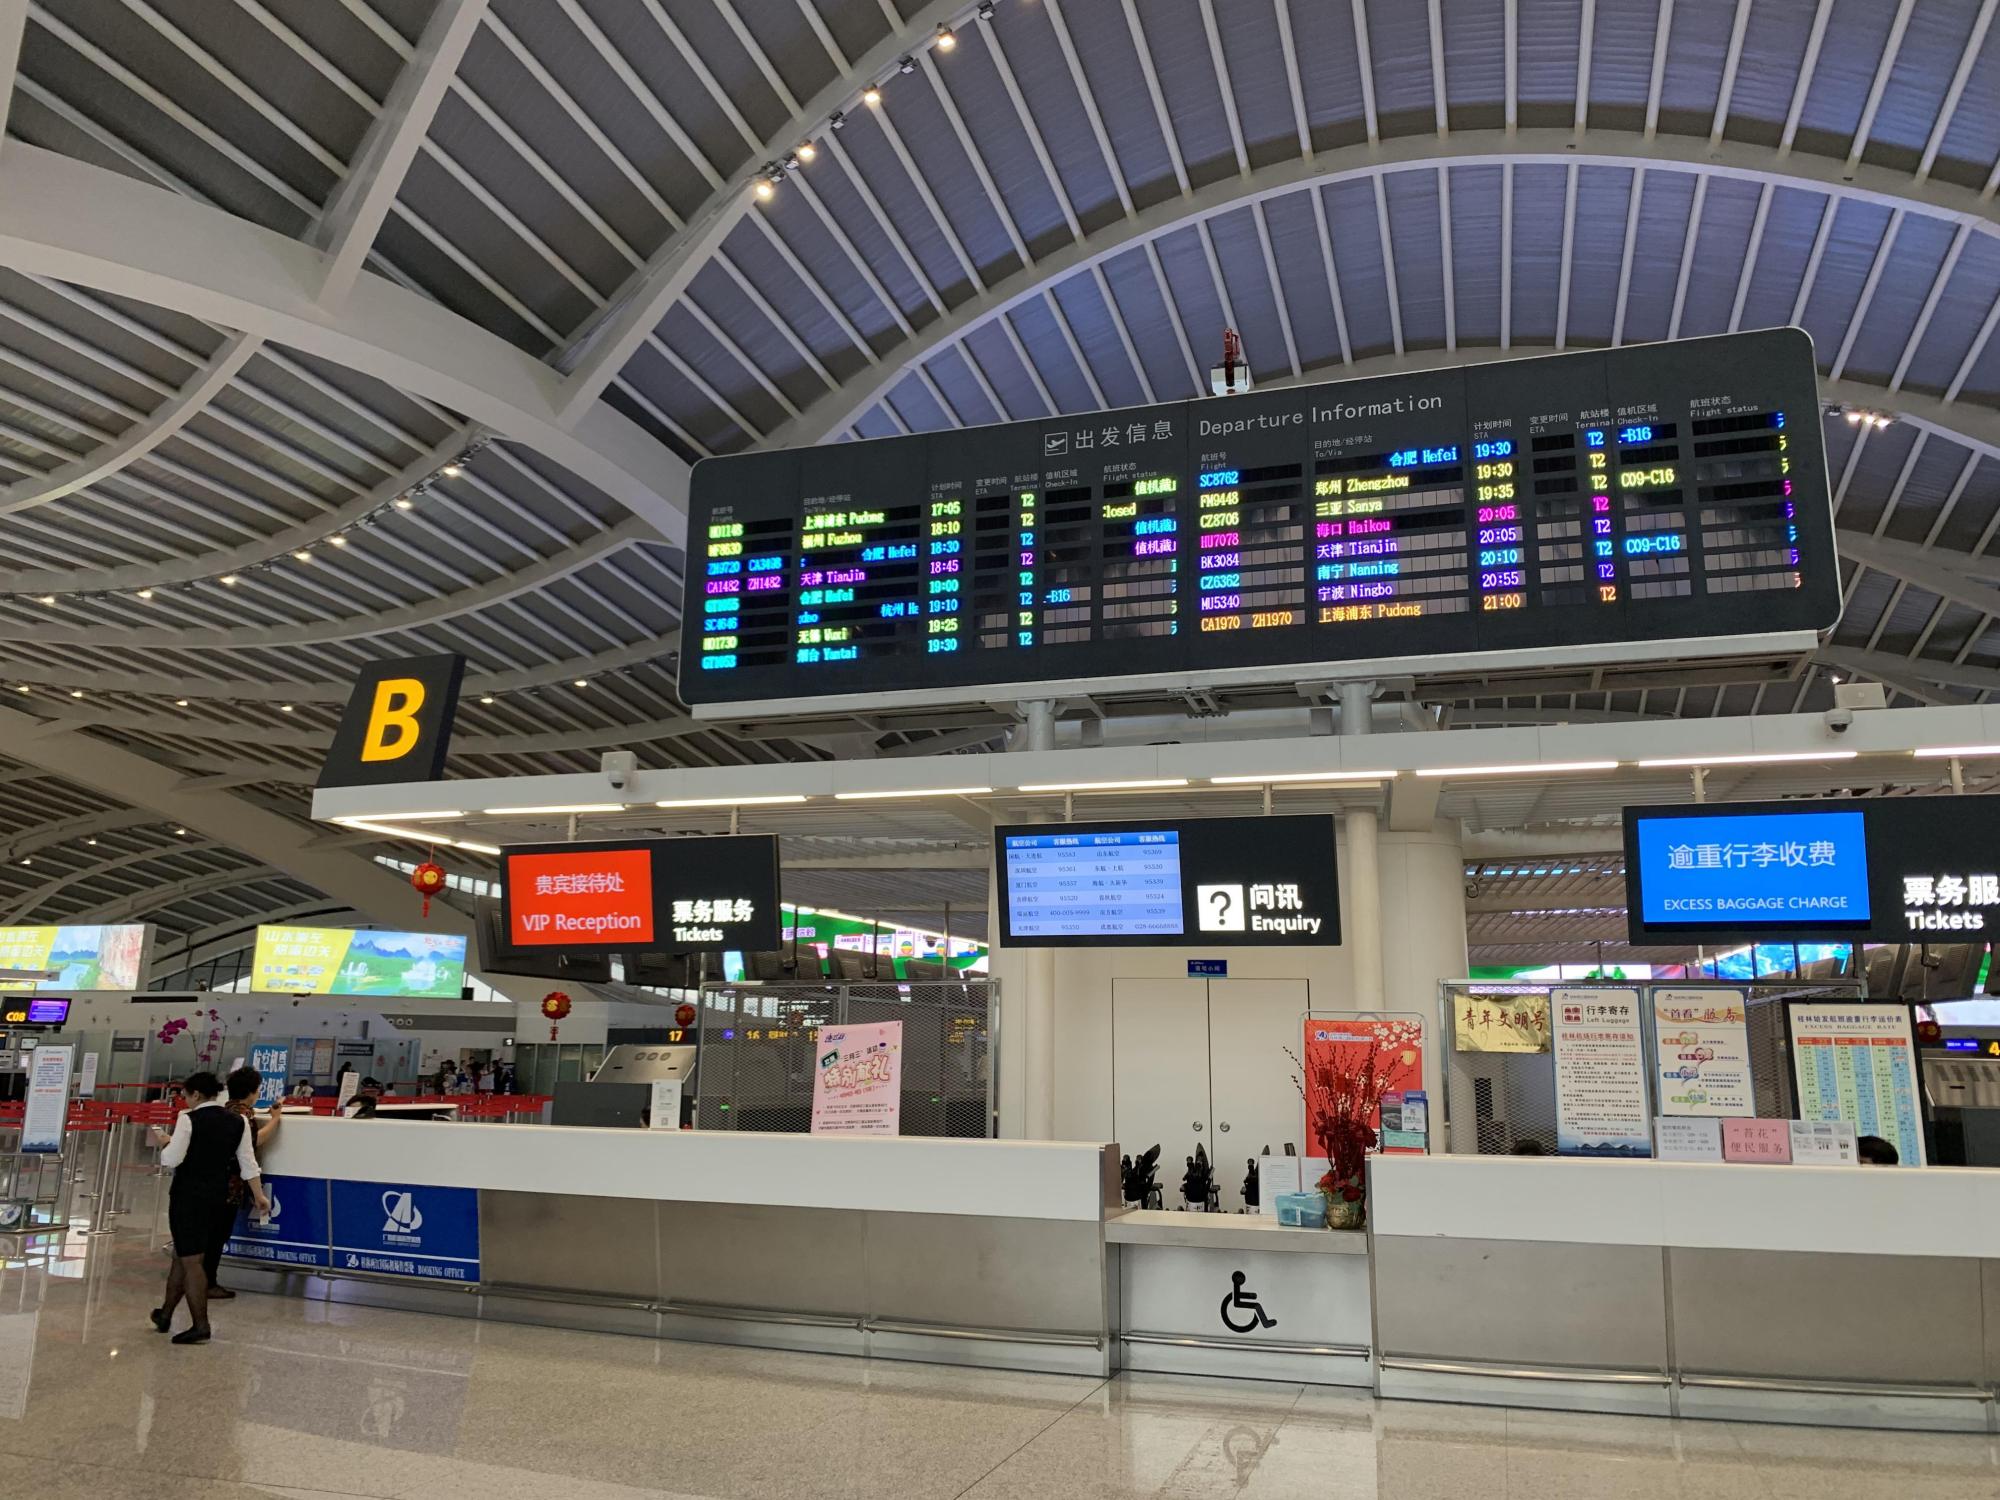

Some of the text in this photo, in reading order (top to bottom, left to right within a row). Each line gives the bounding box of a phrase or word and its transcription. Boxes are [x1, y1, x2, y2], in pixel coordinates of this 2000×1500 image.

[1617, 404, 1658, 416] 值机区域
[1690, 396, 1732, 408] 航班状态
[1580, 408, 1610, 420] 航站楼
[1690, 404, 1758, 418] Flight status
[1075, 396, 1442, 449] 出发信息 Departure Information
[1474, 419, 1512, 430] 计划时间
[1529, 413, 1569, 426] 变更时间
[1575, 418, 1614, 430] Terminal
[1617, 414, 1658, 426] Check-In
[1474, 431, 1489, 440] STA
[1530, 425, 1545, 434] ETA
[1618, 427, 1652, 444] -B16
[1588, 432, 1604, 446] T2
[1201, 452, 1227, 462] 航班号
[1315, 449, 1342, 459] To/Via
[1390, 447, 1458, 468] 合肥 Hefei
[1475, 442, 1511, 458] 19:30
[1103, 462, 1137, 474] 航班状态
[1200, 461, 1227, 470] Flight
[1590, 453, 1606, 468] T2
[1103, 472, 1128, 482] Flight
[1200, 472, 1239, 488] SC8762
[1476, 464, 1513, 480] 19:30
[1620, 468, 1675, 488] C09-C16
[1316, 474, 1409, 496] 郑州 Zhengzhou
[1592, 475, 1608, 490] T2
[930, 492, 943, 500] STA
[976, 488, 988, 496] ETA
[1021, 493, 1035, 507] T2
[1200, 491, 1239, 508] FM9448
[1478, 484, 1514, 501] 19:35
[931, 502, 960, 516] 17:05
[1103, 502, 1137, 518] losed
[1316, 498, 1383, 517] 三亚 Sanya
[1593, 496, 1610, 512] T2
[850, 511, 884, 526] Pudong
[1021, 512, 1034, 526] T2
[1200, 512, 1239, 528] CZ8706
[1478, 506, 1516, 522] 20:05
[930, 520, 960, 536] 18:10
[1316, 520, 1390, 538] 海口 Haikou
[1595, 518, 1612, 534] T2
[828, 532, 862, 546] Fuzhou
[1020, 532, 1034, 546] T2
[1200, 532, 1240, 549] HU7078
[1480, 528, 1517, 544] 20:05
[930, 540, 960, 554] 18:30
[1316, 540, 1398, 559] 天津 Tianjin
[1596, 540, 1613, 556] T2
[1626, 535, 1680, 554] C09-C16
[862, 544, 917, 562] 合肥 Hefei
[1020, 552, 1034, 566] T2
[1480, 550, 1518, 566] 20:10
[930, 559, 960, 574] 18:45
[1200, 553, 1240, 570] BK3084
[801, 570, 866, 586] 天津 Tianjin
[1317, 560, 1400, 580] 南宁 Nanning
[1598, 563, 1615, 578] T2
[706, 576, 781, 594] CA1482 ZH1482
[929, 579, 959, 594] 19:00
[1020, 572, 1033, 586] T2
[1200, 573, 1240, 590] CZ6362
[1482, 572, 1520, 588] 20:55
[1020, 592, 1033, 605] T2
[1318, 583, 1393, 602] 宁波 Ningbo
[1600, 586, 1617, 601] T2
[929, 598, 958, 613] 19:10
[1201, 594, 1240, 611] MU5340
[1484, 594, 1521, 610] 21:00
[880, 604, 904, 618] 杭州
[1020, 612, 1032, 625] T2
[1318, 602, 1422, 624] 上海浦东 Pudong
[928, 618, 958, 634] 19:25
[1202, 612, 1292, 632] CA1970 ZH1970
[928, 638, 958, 652] 19:30
[1019, 632, 1032, 646] T2
[823, 646, 858, 662] Yantai
[361, 678, 426, 762] B
[1668, 840, 1836, 870] 逾重行李收费
[535, 872, 624, 895] 贵宾接待处
[1904, 876, 2000, 906] 票务服
[1250, 883, 1302, 911] 问讯
[1664, 896, 1848, 911] EXCESS BAGGAGE CHARGE
[672, 899, 754, 924] 票务服务
[522, 912, 642, 934] VIP Reception
[1252, 915, 1321, 934] Enquiry
[1905, 911, 1984, 930] Tickets
[673, 926, 724, 942] Tickets
[1586, 1006, 1630, 1016] 行李寄存
[1461, 1007, 1545, 1032] 青年文明号
[668, 1030, 684, 1042] 17
[444, 1267, 465, 1278] OFFICE
